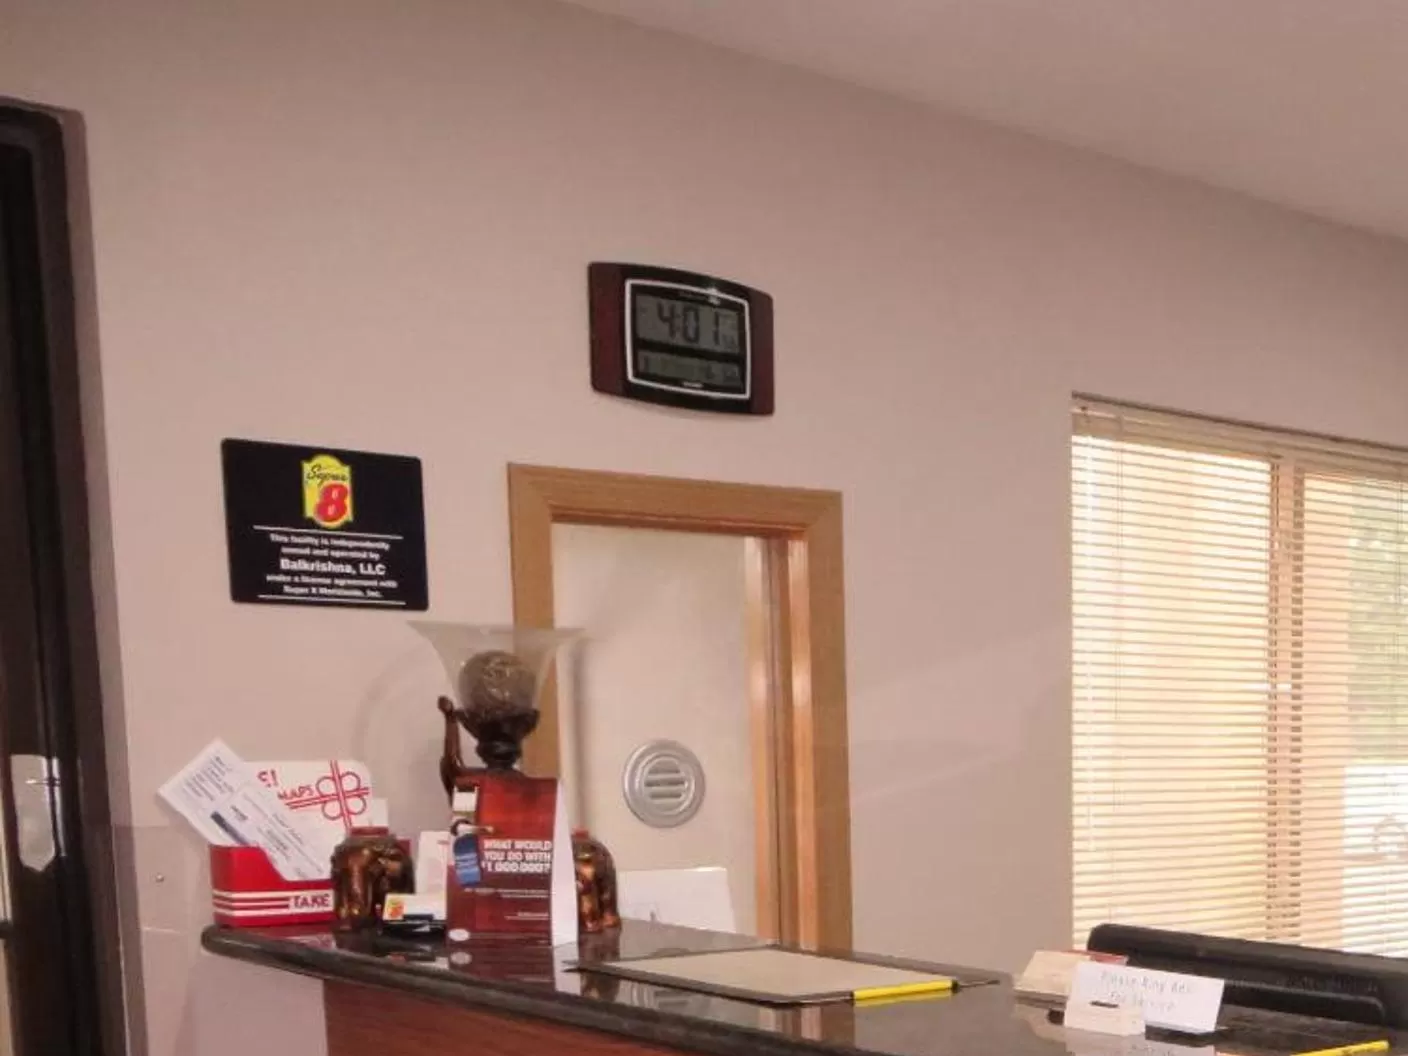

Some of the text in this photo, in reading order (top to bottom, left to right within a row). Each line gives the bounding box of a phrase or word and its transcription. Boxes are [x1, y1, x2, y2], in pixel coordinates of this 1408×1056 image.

[306, 463, 348, 486] Super
[315, 481, 350, 523] 8
[358, 562, 387, 576] LLC
[484, 839, 553, 852] WHAT WOULD
[484, 850, 552, 863] YOU DO WITH
[292, 893, 331, 911] TAKE
